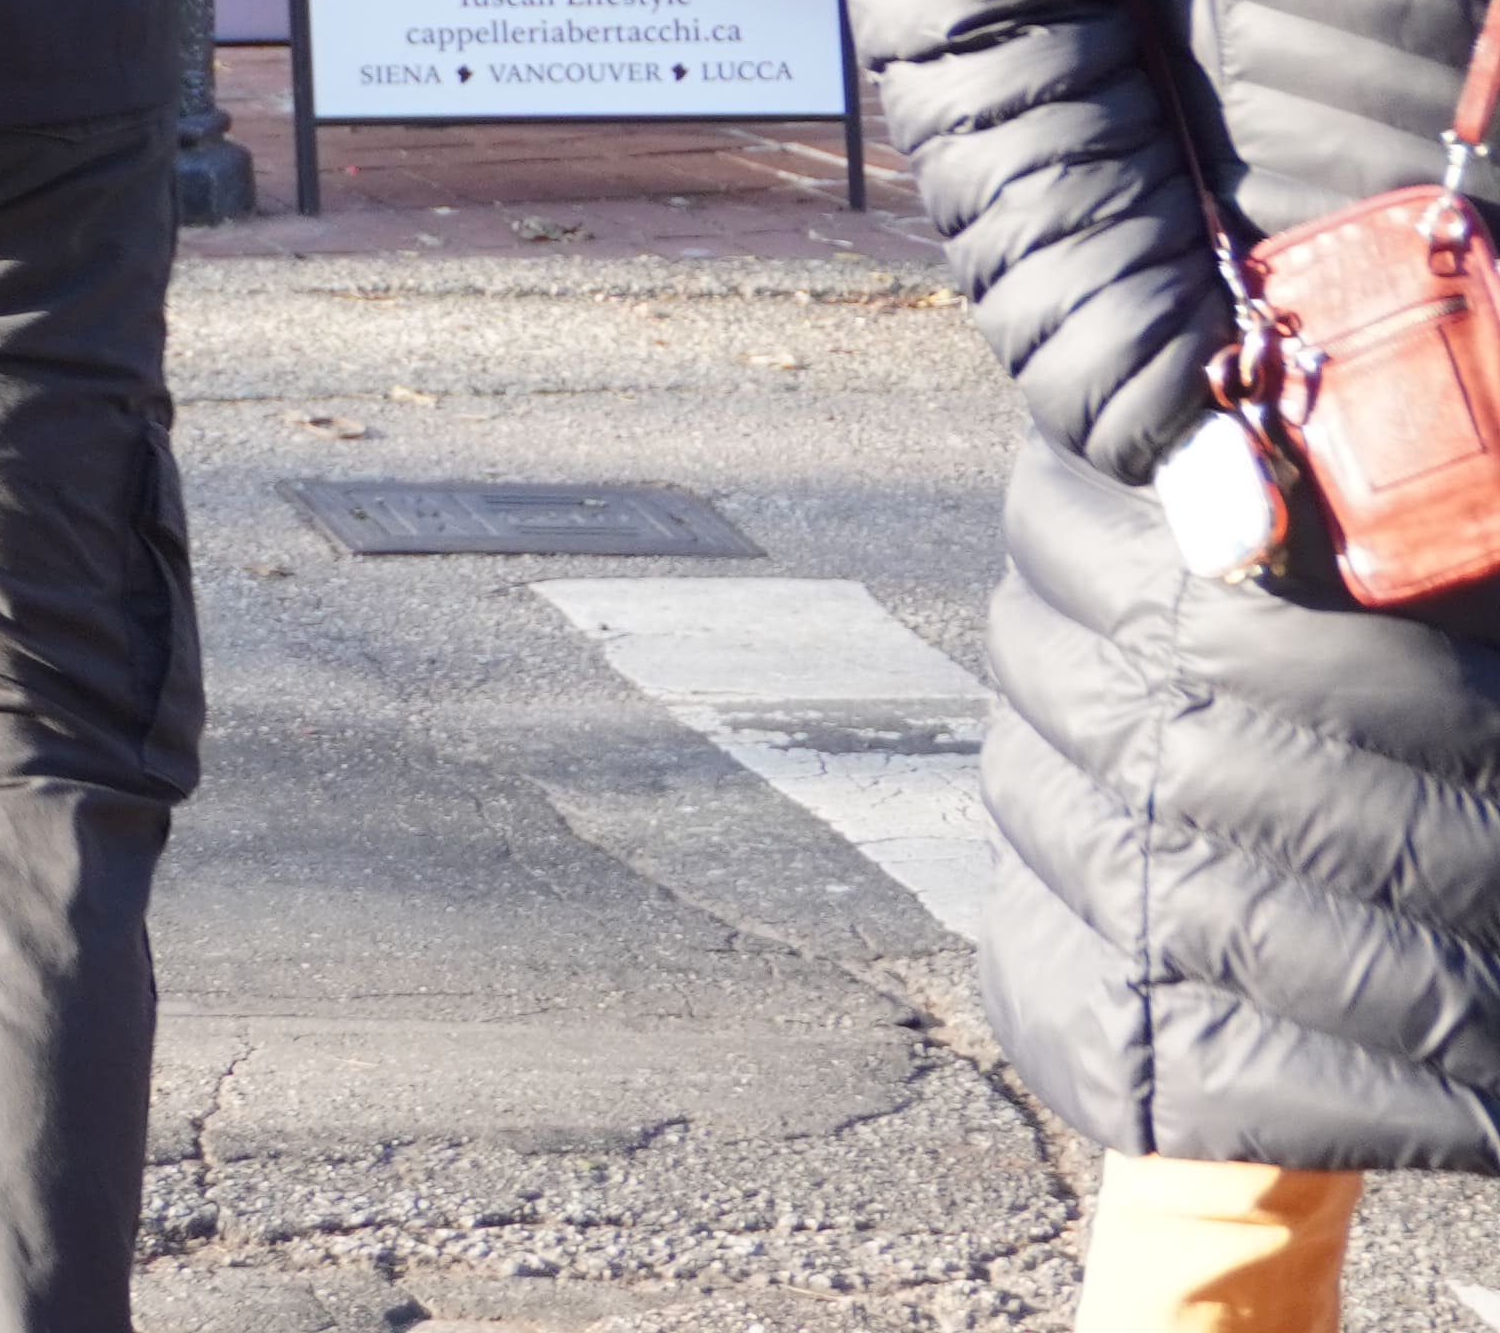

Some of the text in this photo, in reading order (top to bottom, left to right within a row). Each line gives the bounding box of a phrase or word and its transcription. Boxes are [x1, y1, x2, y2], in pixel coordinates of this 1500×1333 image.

[405, 18, 743, 53] cappelleriabertacchi.ca
[359, 60, 794, 85] SIENA VANCOUVER LUCCA
